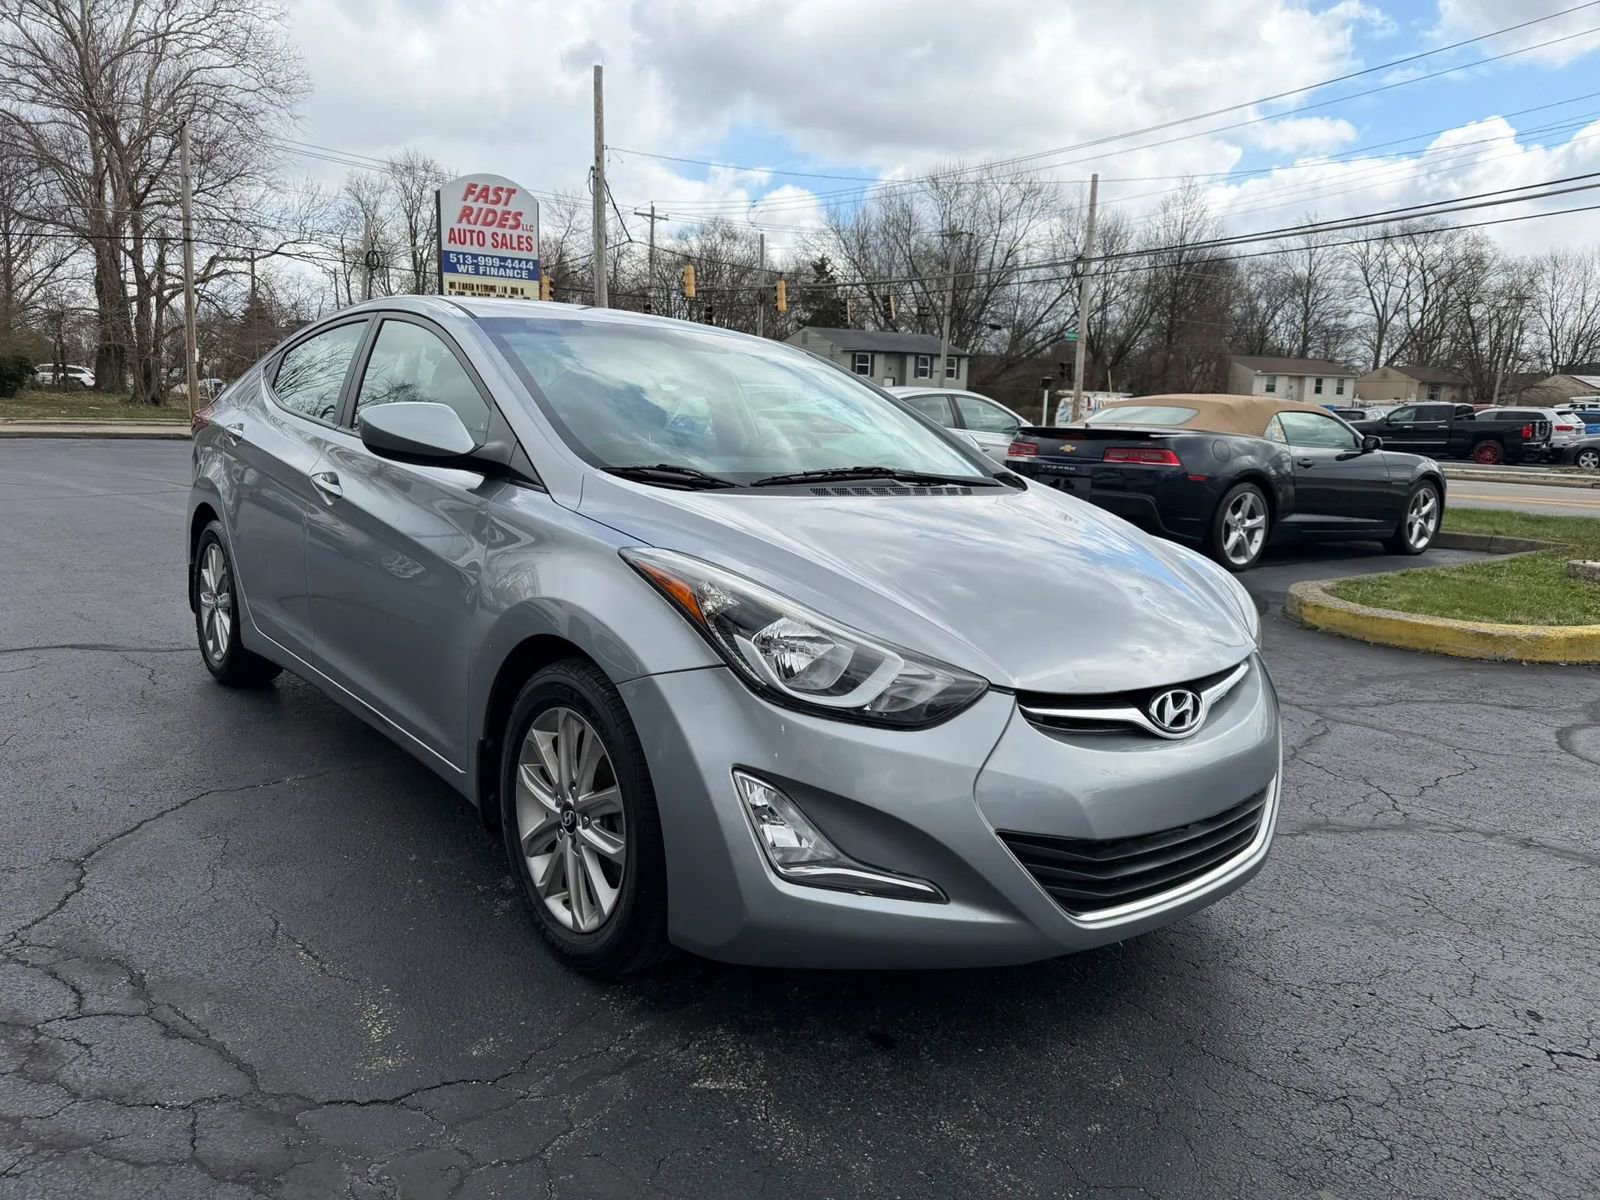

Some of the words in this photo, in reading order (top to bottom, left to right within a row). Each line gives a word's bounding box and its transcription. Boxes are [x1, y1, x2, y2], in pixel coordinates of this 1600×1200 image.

[462, 183, 516, 206] FAST
[456, 205, 523, 230] RIDES
[522, 224, 534, 233] LLC
[448, 227, 486, 248] AUTO
[491, 231, 533, 253] SALES
[449, 253, 534, 270] 513-999-4444
[456, 263, 475, 274] WE
[480, 266, 529, 279] FINANCE
